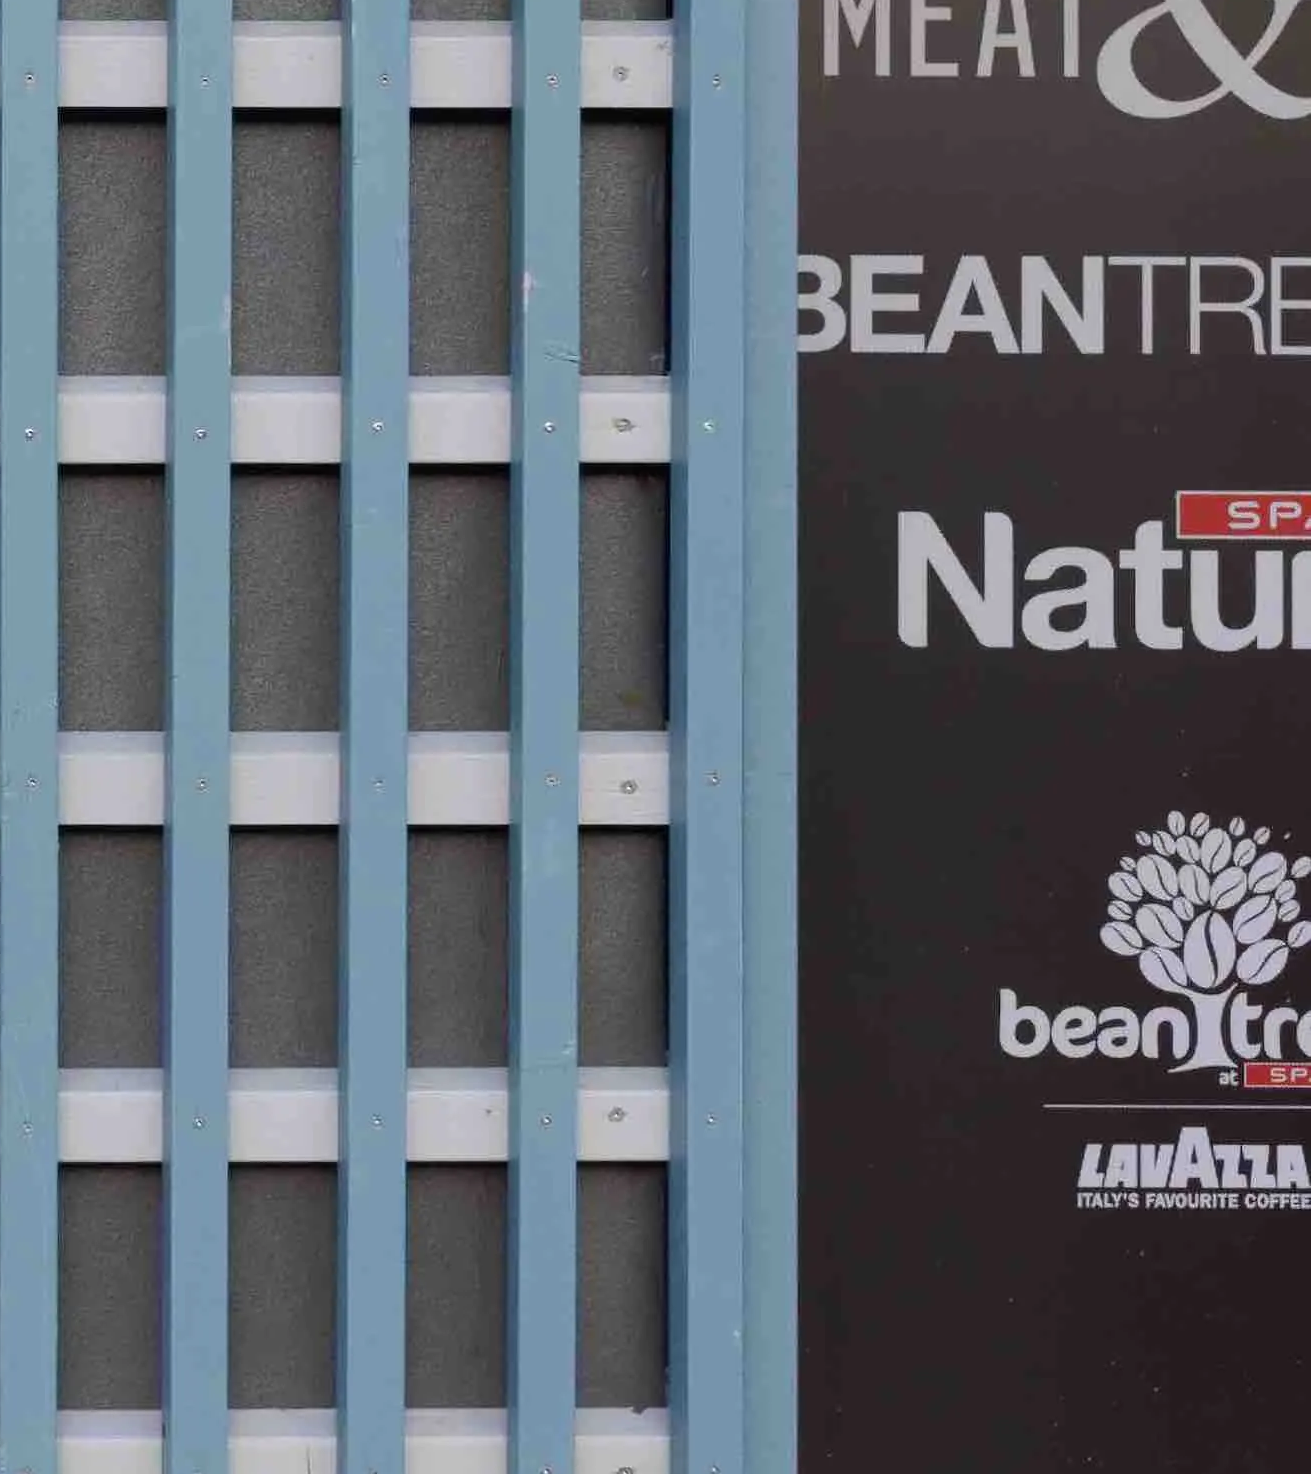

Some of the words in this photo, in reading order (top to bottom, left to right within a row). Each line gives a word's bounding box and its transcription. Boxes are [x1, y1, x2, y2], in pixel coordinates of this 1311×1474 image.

[1227, 501, 1311, 530] SP
[999, 988, 1190, 1059] bean
[1219, 1071, 1239, 1086] at
[1270, 1068, 1311, 1083] SP
[1078, 1126, 1311, 1188] LAVAZZA
[1078, 1192, 1140, 1209] ITALY'S
[1144, 1193, 1239, 1209] FAVOURITE
[1244, 1193, 1311, 1210] COFFEE
